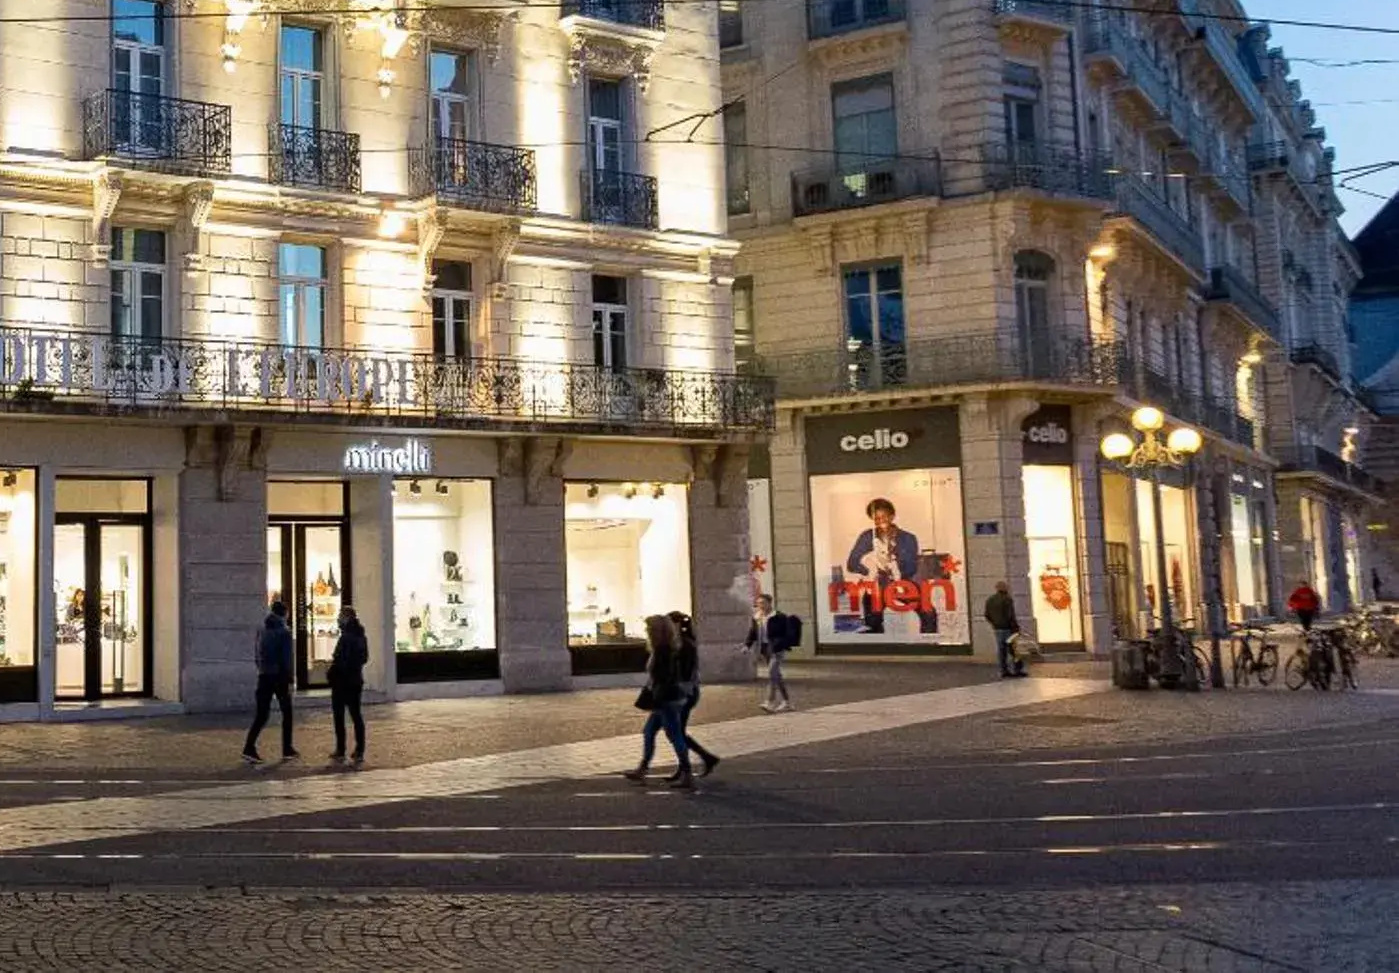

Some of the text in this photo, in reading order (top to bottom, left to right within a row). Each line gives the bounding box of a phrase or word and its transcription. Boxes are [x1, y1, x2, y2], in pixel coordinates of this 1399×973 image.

[344, 436, 431, 472] minelli
[840, 429, 909, 452] celio
[828, 577, 958, 613] men
